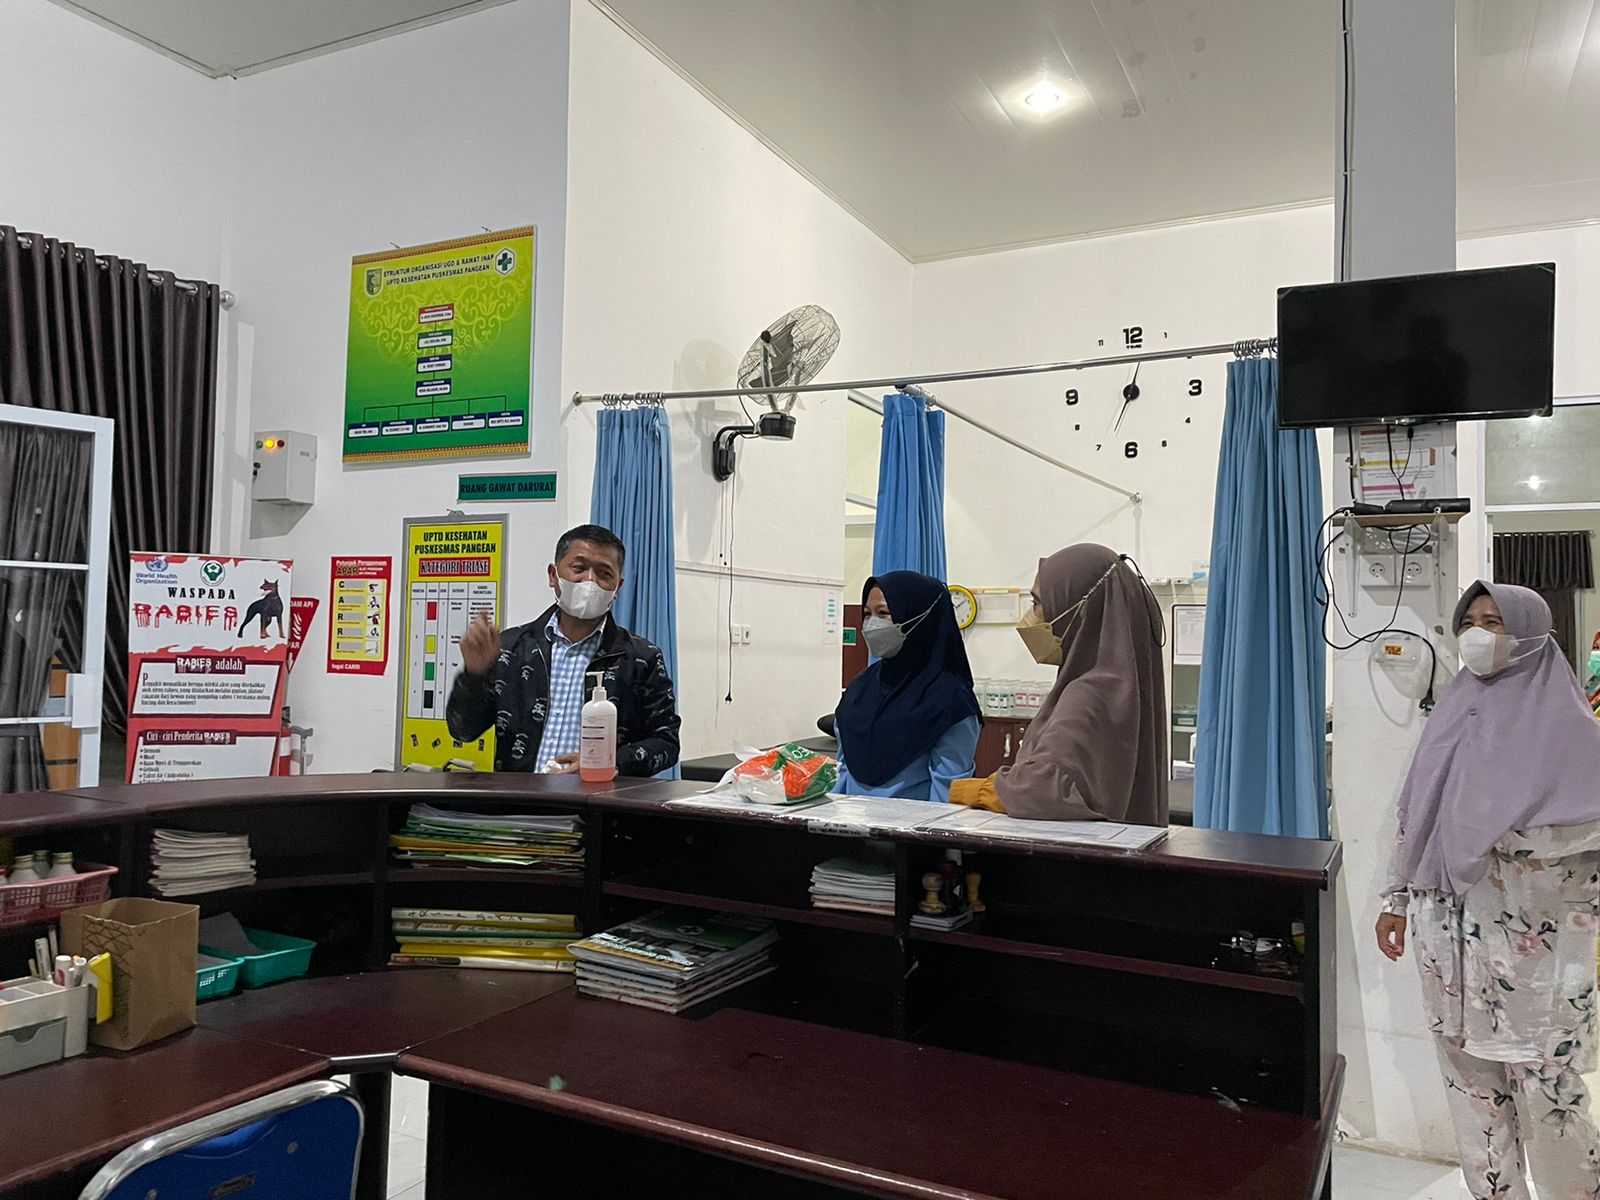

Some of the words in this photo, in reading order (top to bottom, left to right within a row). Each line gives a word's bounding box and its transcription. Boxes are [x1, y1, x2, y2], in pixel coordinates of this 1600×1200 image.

[384, 267, 410, 278] STRUKTUR
[411, 262, 442, 273] ORGANISASI
[461, 256, 480, 265] RAWAT
[480, 254, 494, 262] INAP
[400, 272, 431, 284] KESEHATAN
[432, 268, 464, 279] PUSKESMAS
[464, 264, 490, 274] PANGEAN
[1123, 327, 1143, 344] 12
[1188, 379, 1202, 396] 3
[1066, 389, 1079, 406] 9
[1125, 442, 1138, 458] 6
[460, 483, 487, 494] RUANG
[489, 483, 516, 493] GAWAT
[518, 482, 554, 492] DARURAT
[424, 532, 444, 542] UPTD
[445, 530, 488, 541] KESEHATAN
[414, 544, 460, 554] PUSKESMAS
[461, 543, 496, 553] PANGEAN
[421, 560, 459, 574] KATEGORI
[168, 587, 236, 600] WASPADA
[133, 603, 238, 631] RABIES
[176, 658, 212, 673] RABIES
[215, 658, 243, 670] adalah
[147, 732, 158, 741] Ciri
[162, 732, 173, 741] ciri
[174, 732, 203, 741] Penderita
[204, 732, 230, 743] RABIES
